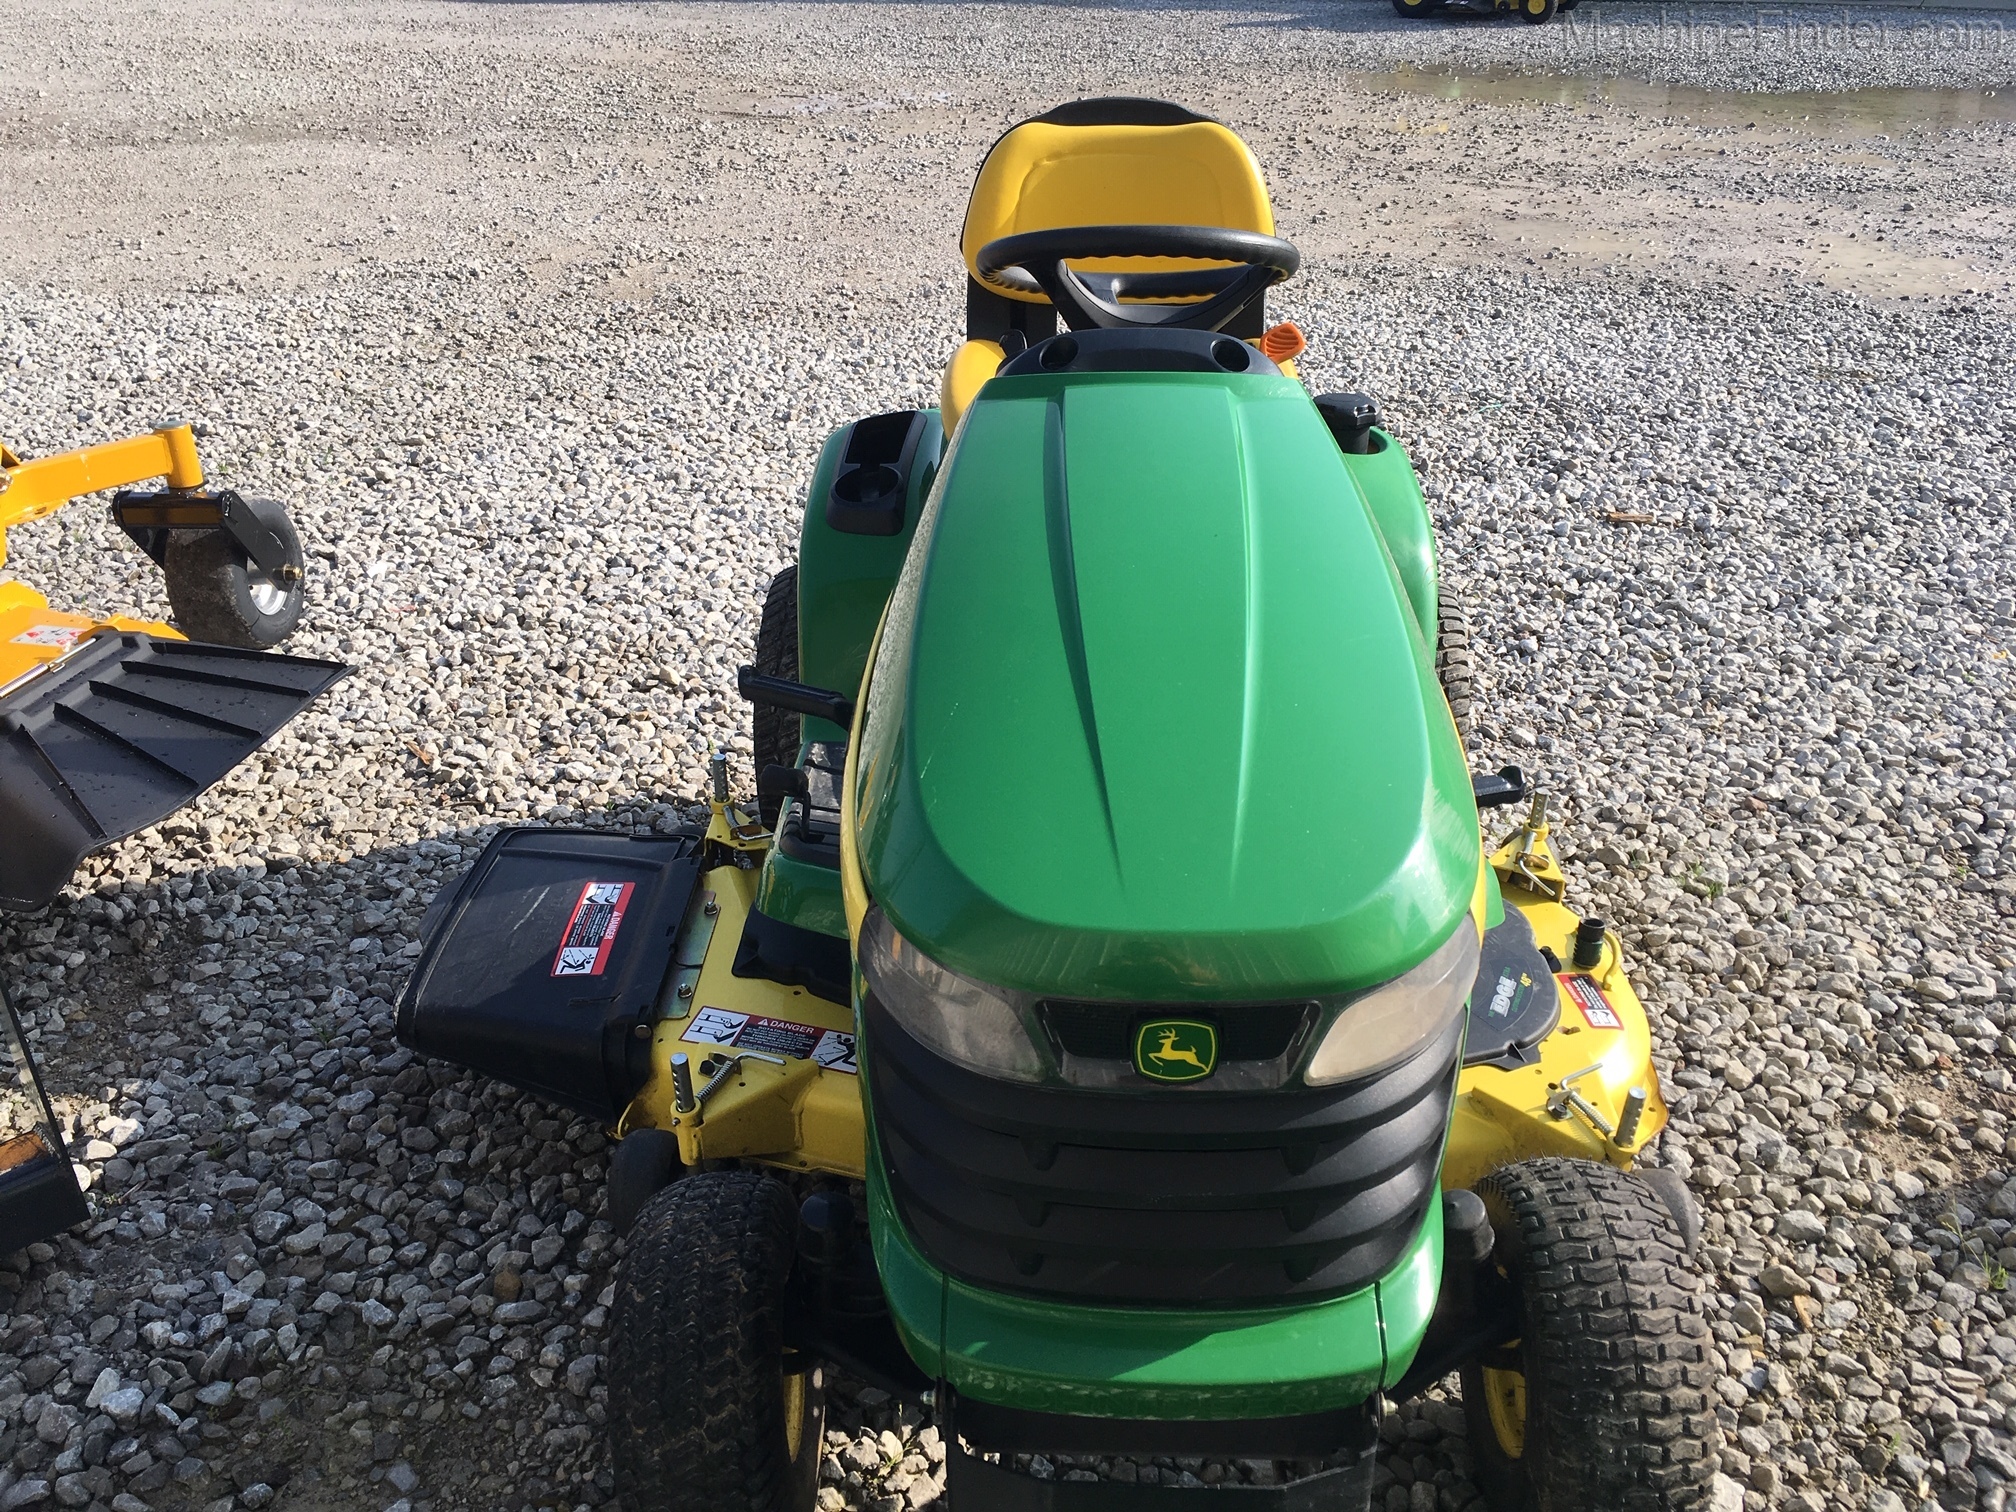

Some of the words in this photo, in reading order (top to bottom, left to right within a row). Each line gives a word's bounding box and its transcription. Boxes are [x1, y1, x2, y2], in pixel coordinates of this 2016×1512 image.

[603, 917, 620, 940] DANGER
[1489, 975, 1517, 1018] EDGE
[770, 1020, 815, 1034] DANGER
